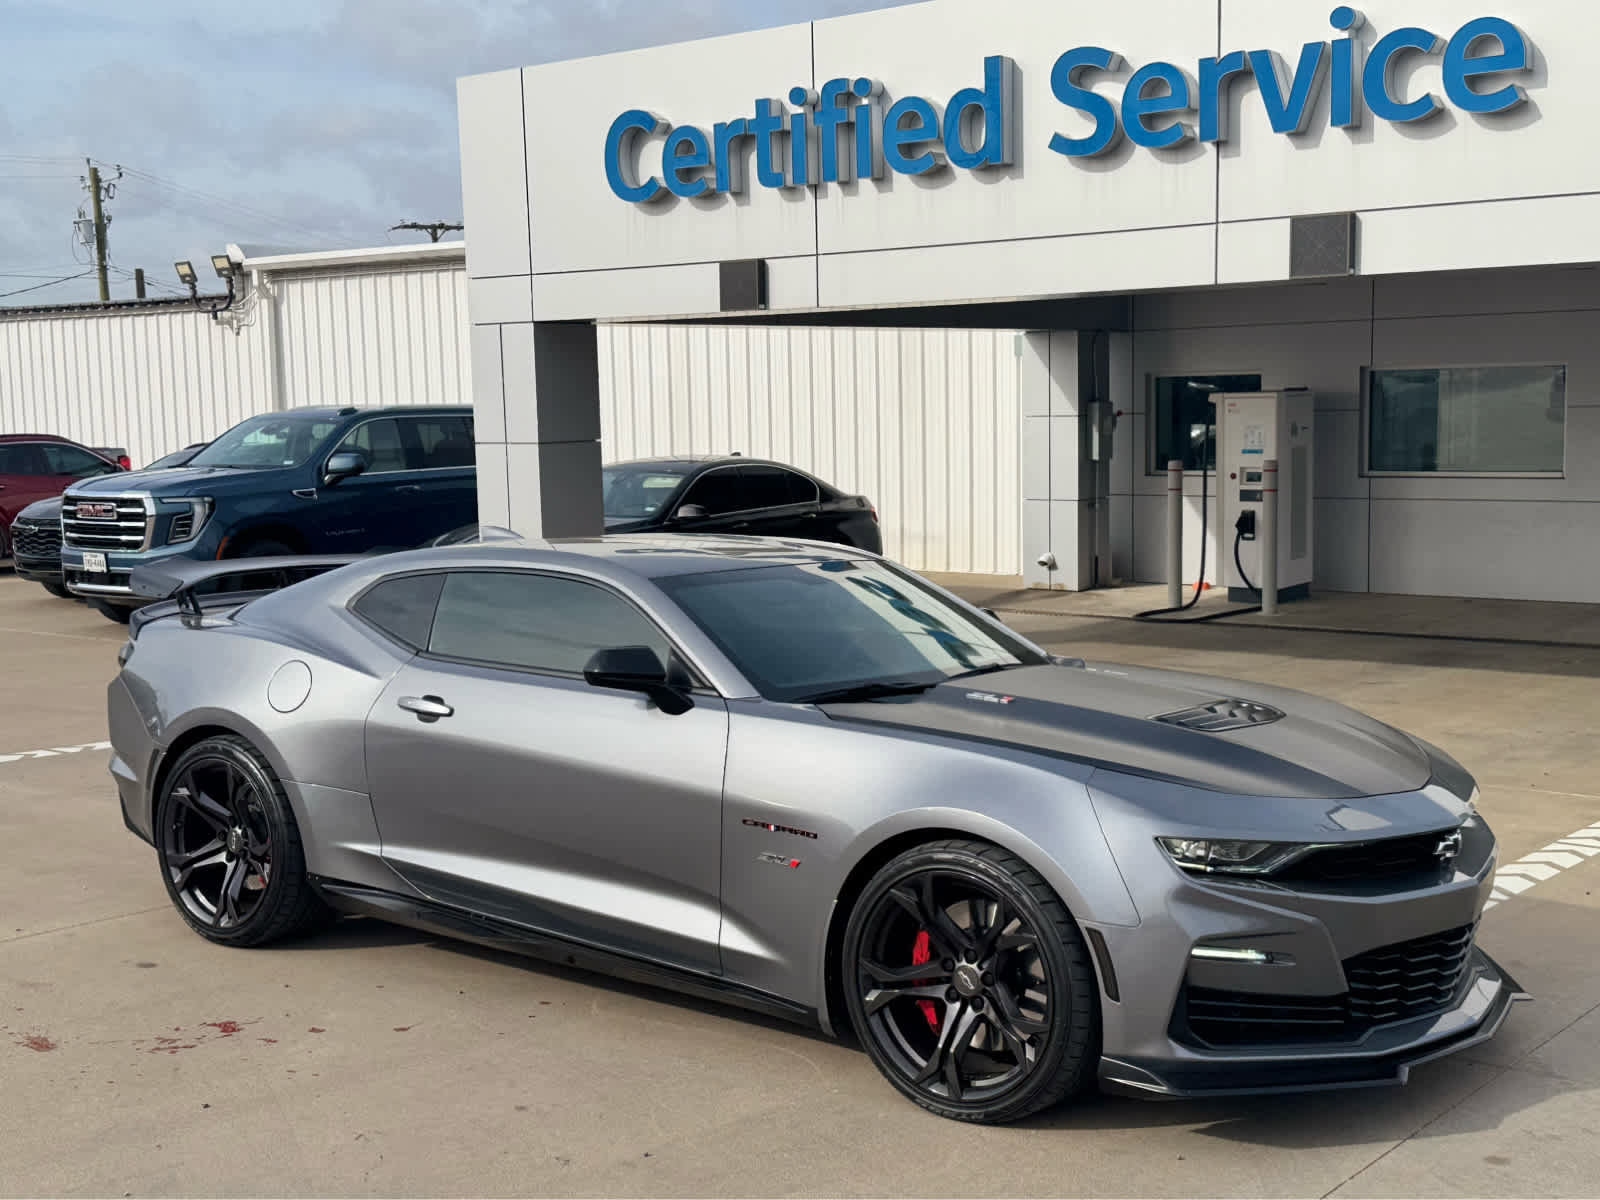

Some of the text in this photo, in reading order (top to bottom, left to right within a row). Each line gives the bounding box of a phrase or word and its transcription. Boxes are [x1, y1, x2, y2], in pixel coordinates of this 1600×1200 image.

[605, 6, 1529, 202] Certified Service
[77, 504, 113, 517] GMC
